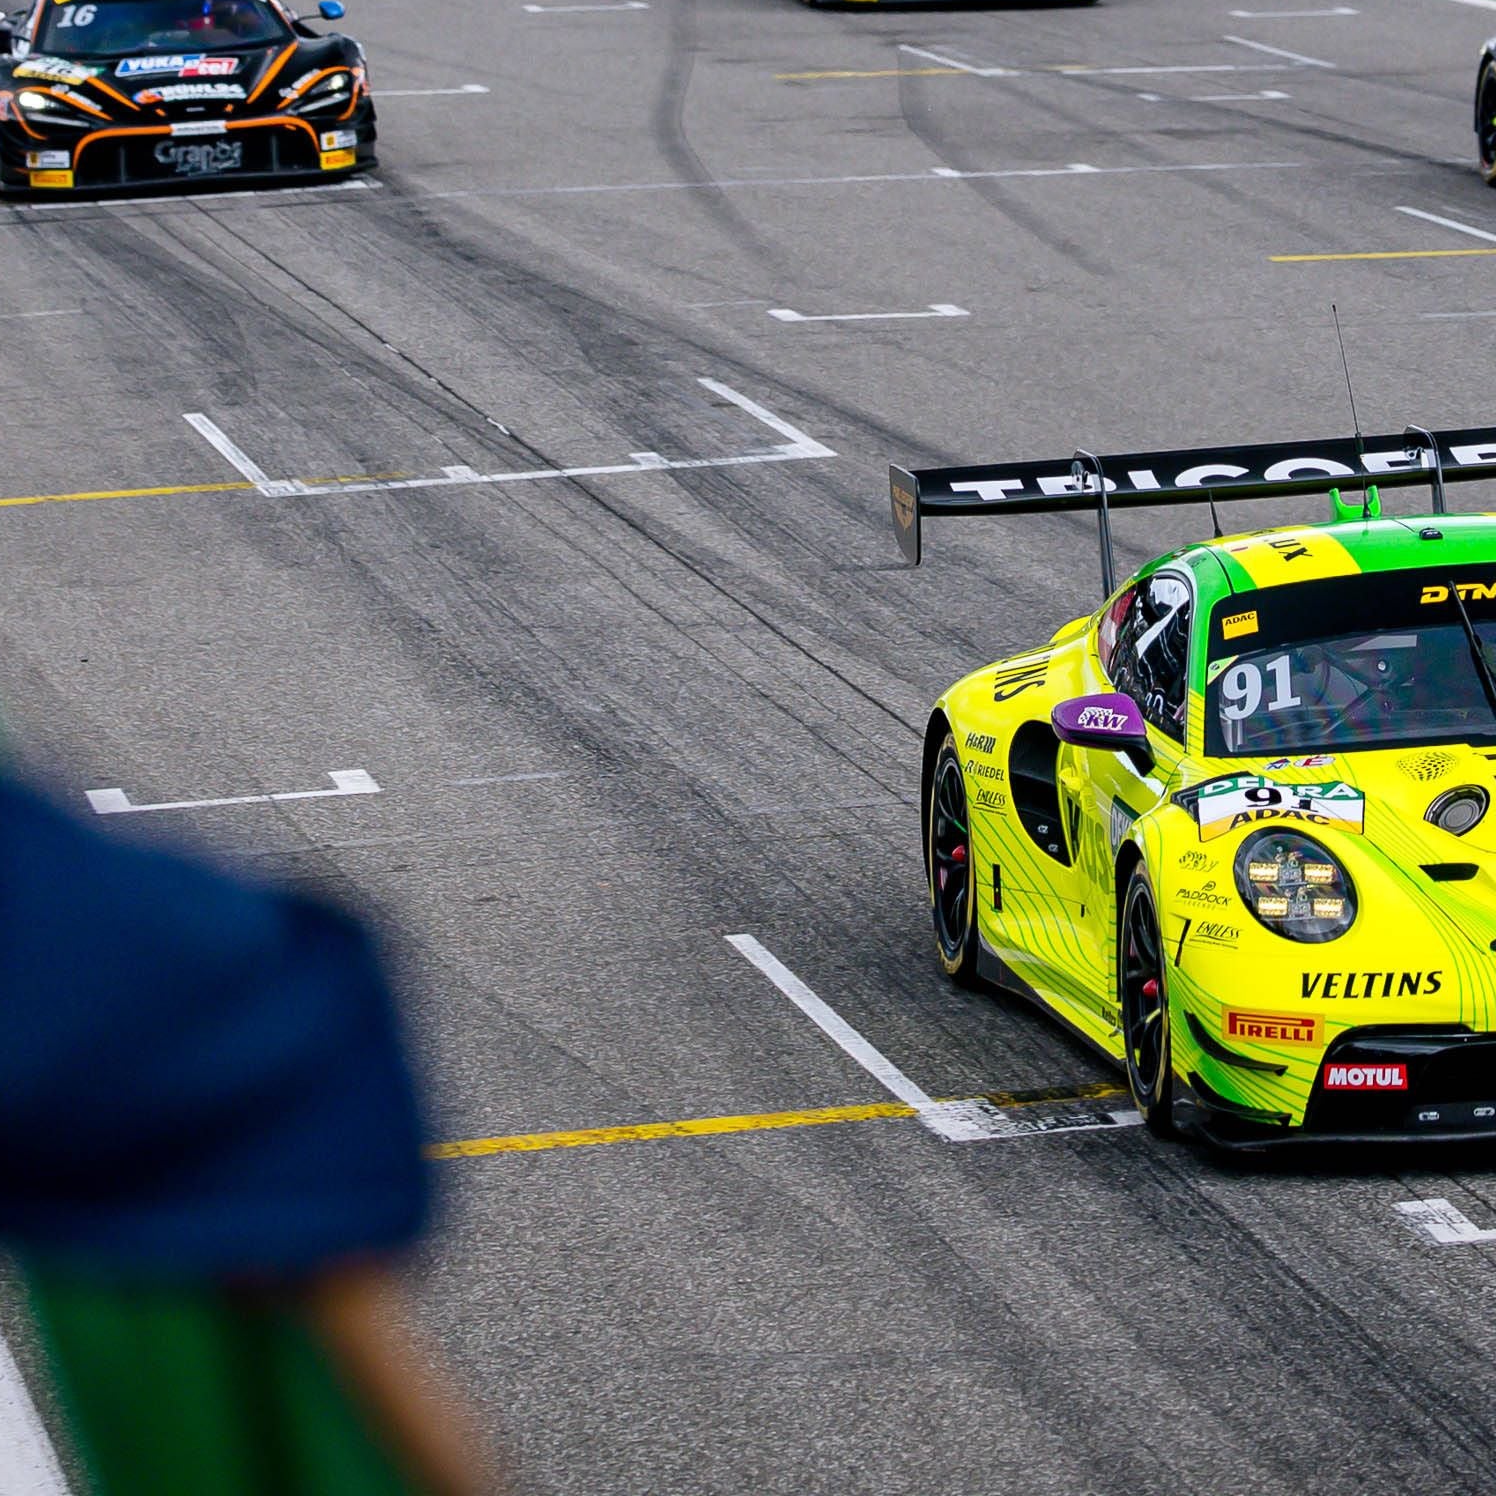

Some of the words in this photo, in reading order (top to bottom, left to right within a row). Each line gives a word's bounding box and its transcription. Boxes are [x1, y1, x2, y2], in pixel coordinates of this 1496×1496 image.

[56, 4, 98, 28] 16
[1224, 611, 1256, 627] ADAC
[1220, 654, 1303, 722] 91
[1084, 711, 1128, 730] KW
[975, 788, 1007, 806] ENDLESS
[1244, 787, 1319, 813] 91
[1229, 809, 1331, 831] ADAC
[1176, 888, 1233, 905] PADDOCK
[1197, 920, 1243, 940] ENDLESS
[1301, 970, 1442, 999] VELTINS
[1228, 1012, 1315, 1042] PIRELLI
[1327, 1066, 1404, 1088] MOTUL
